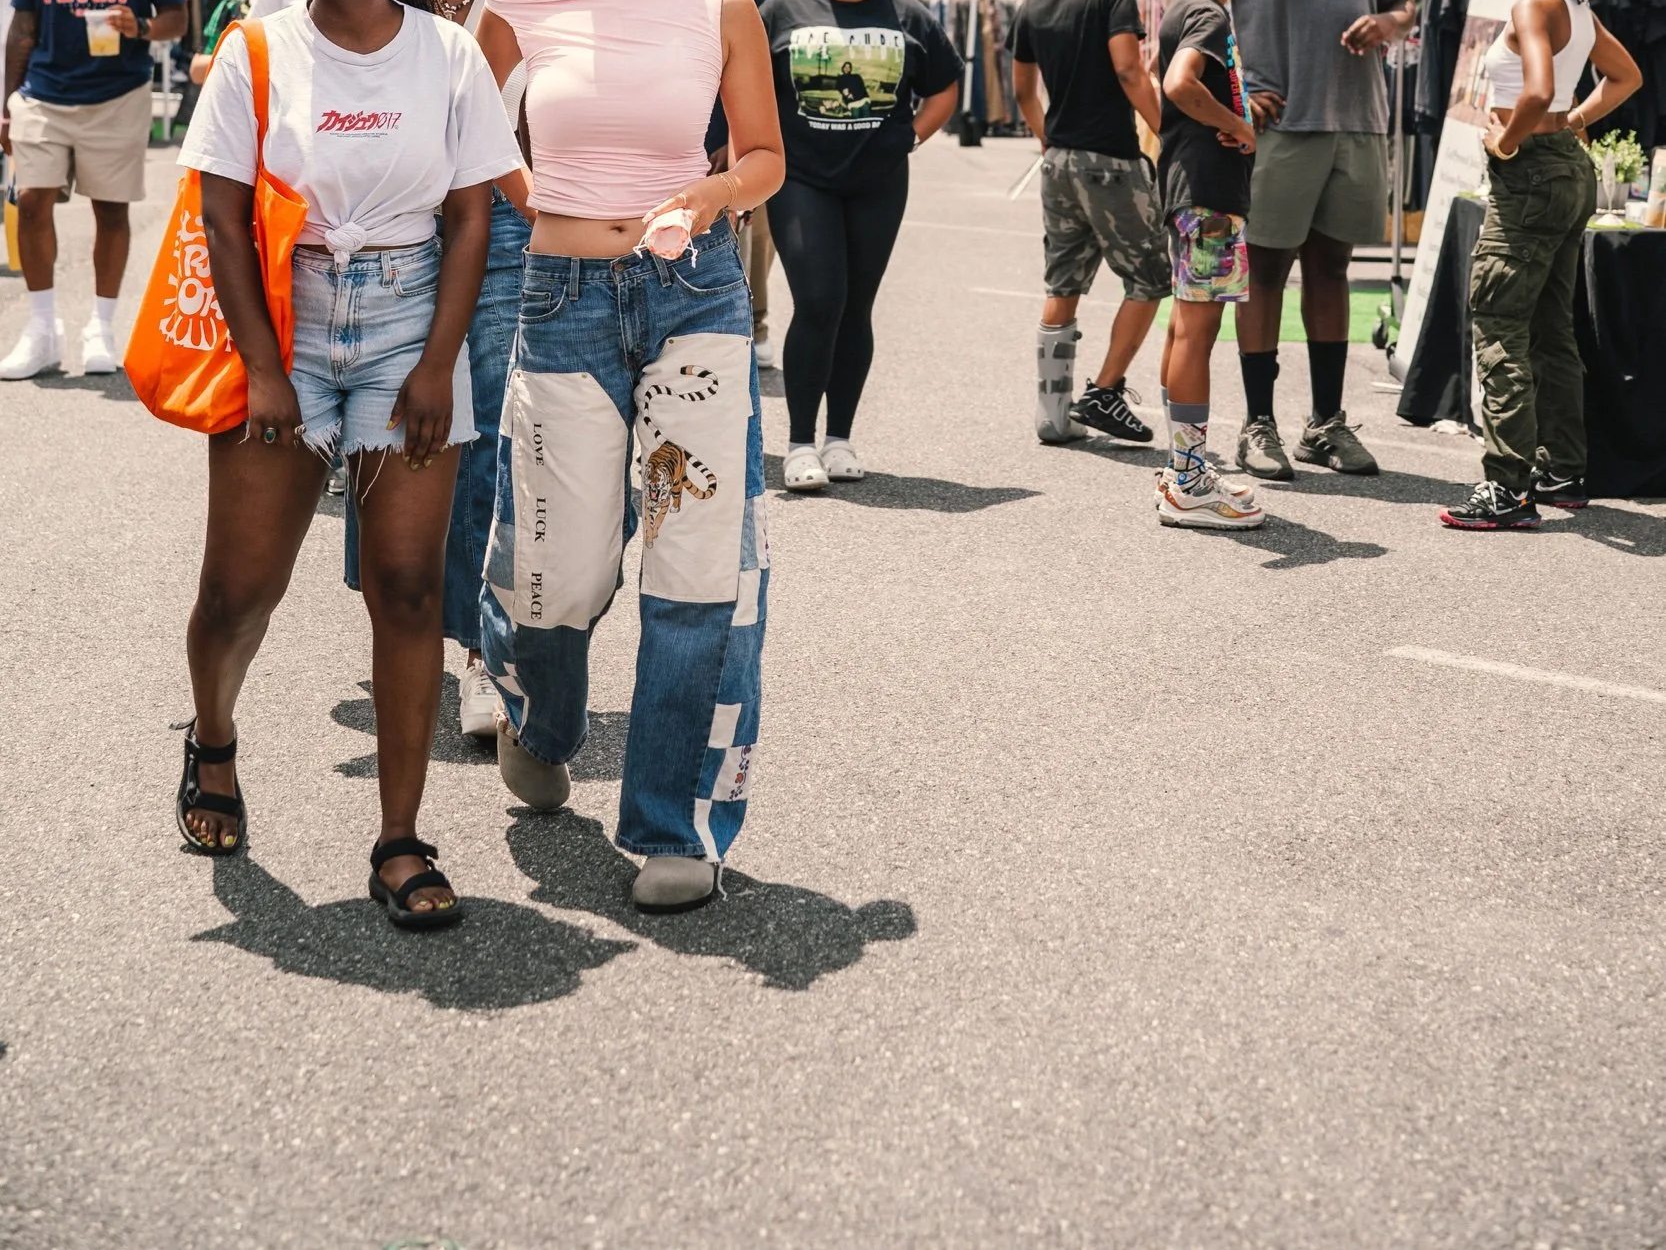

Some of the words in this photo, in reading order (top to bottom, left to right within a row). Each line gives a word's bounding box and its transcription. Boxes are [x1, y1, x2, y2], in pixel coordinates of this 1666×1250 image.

[830, 123, 847, 131] WAS
[847, 123, 853, 131] A
[532, 422, 545, 466] LOVE
[534, 497, 547, 543] LUCK
[530, 571, 543, 620] PEACE
